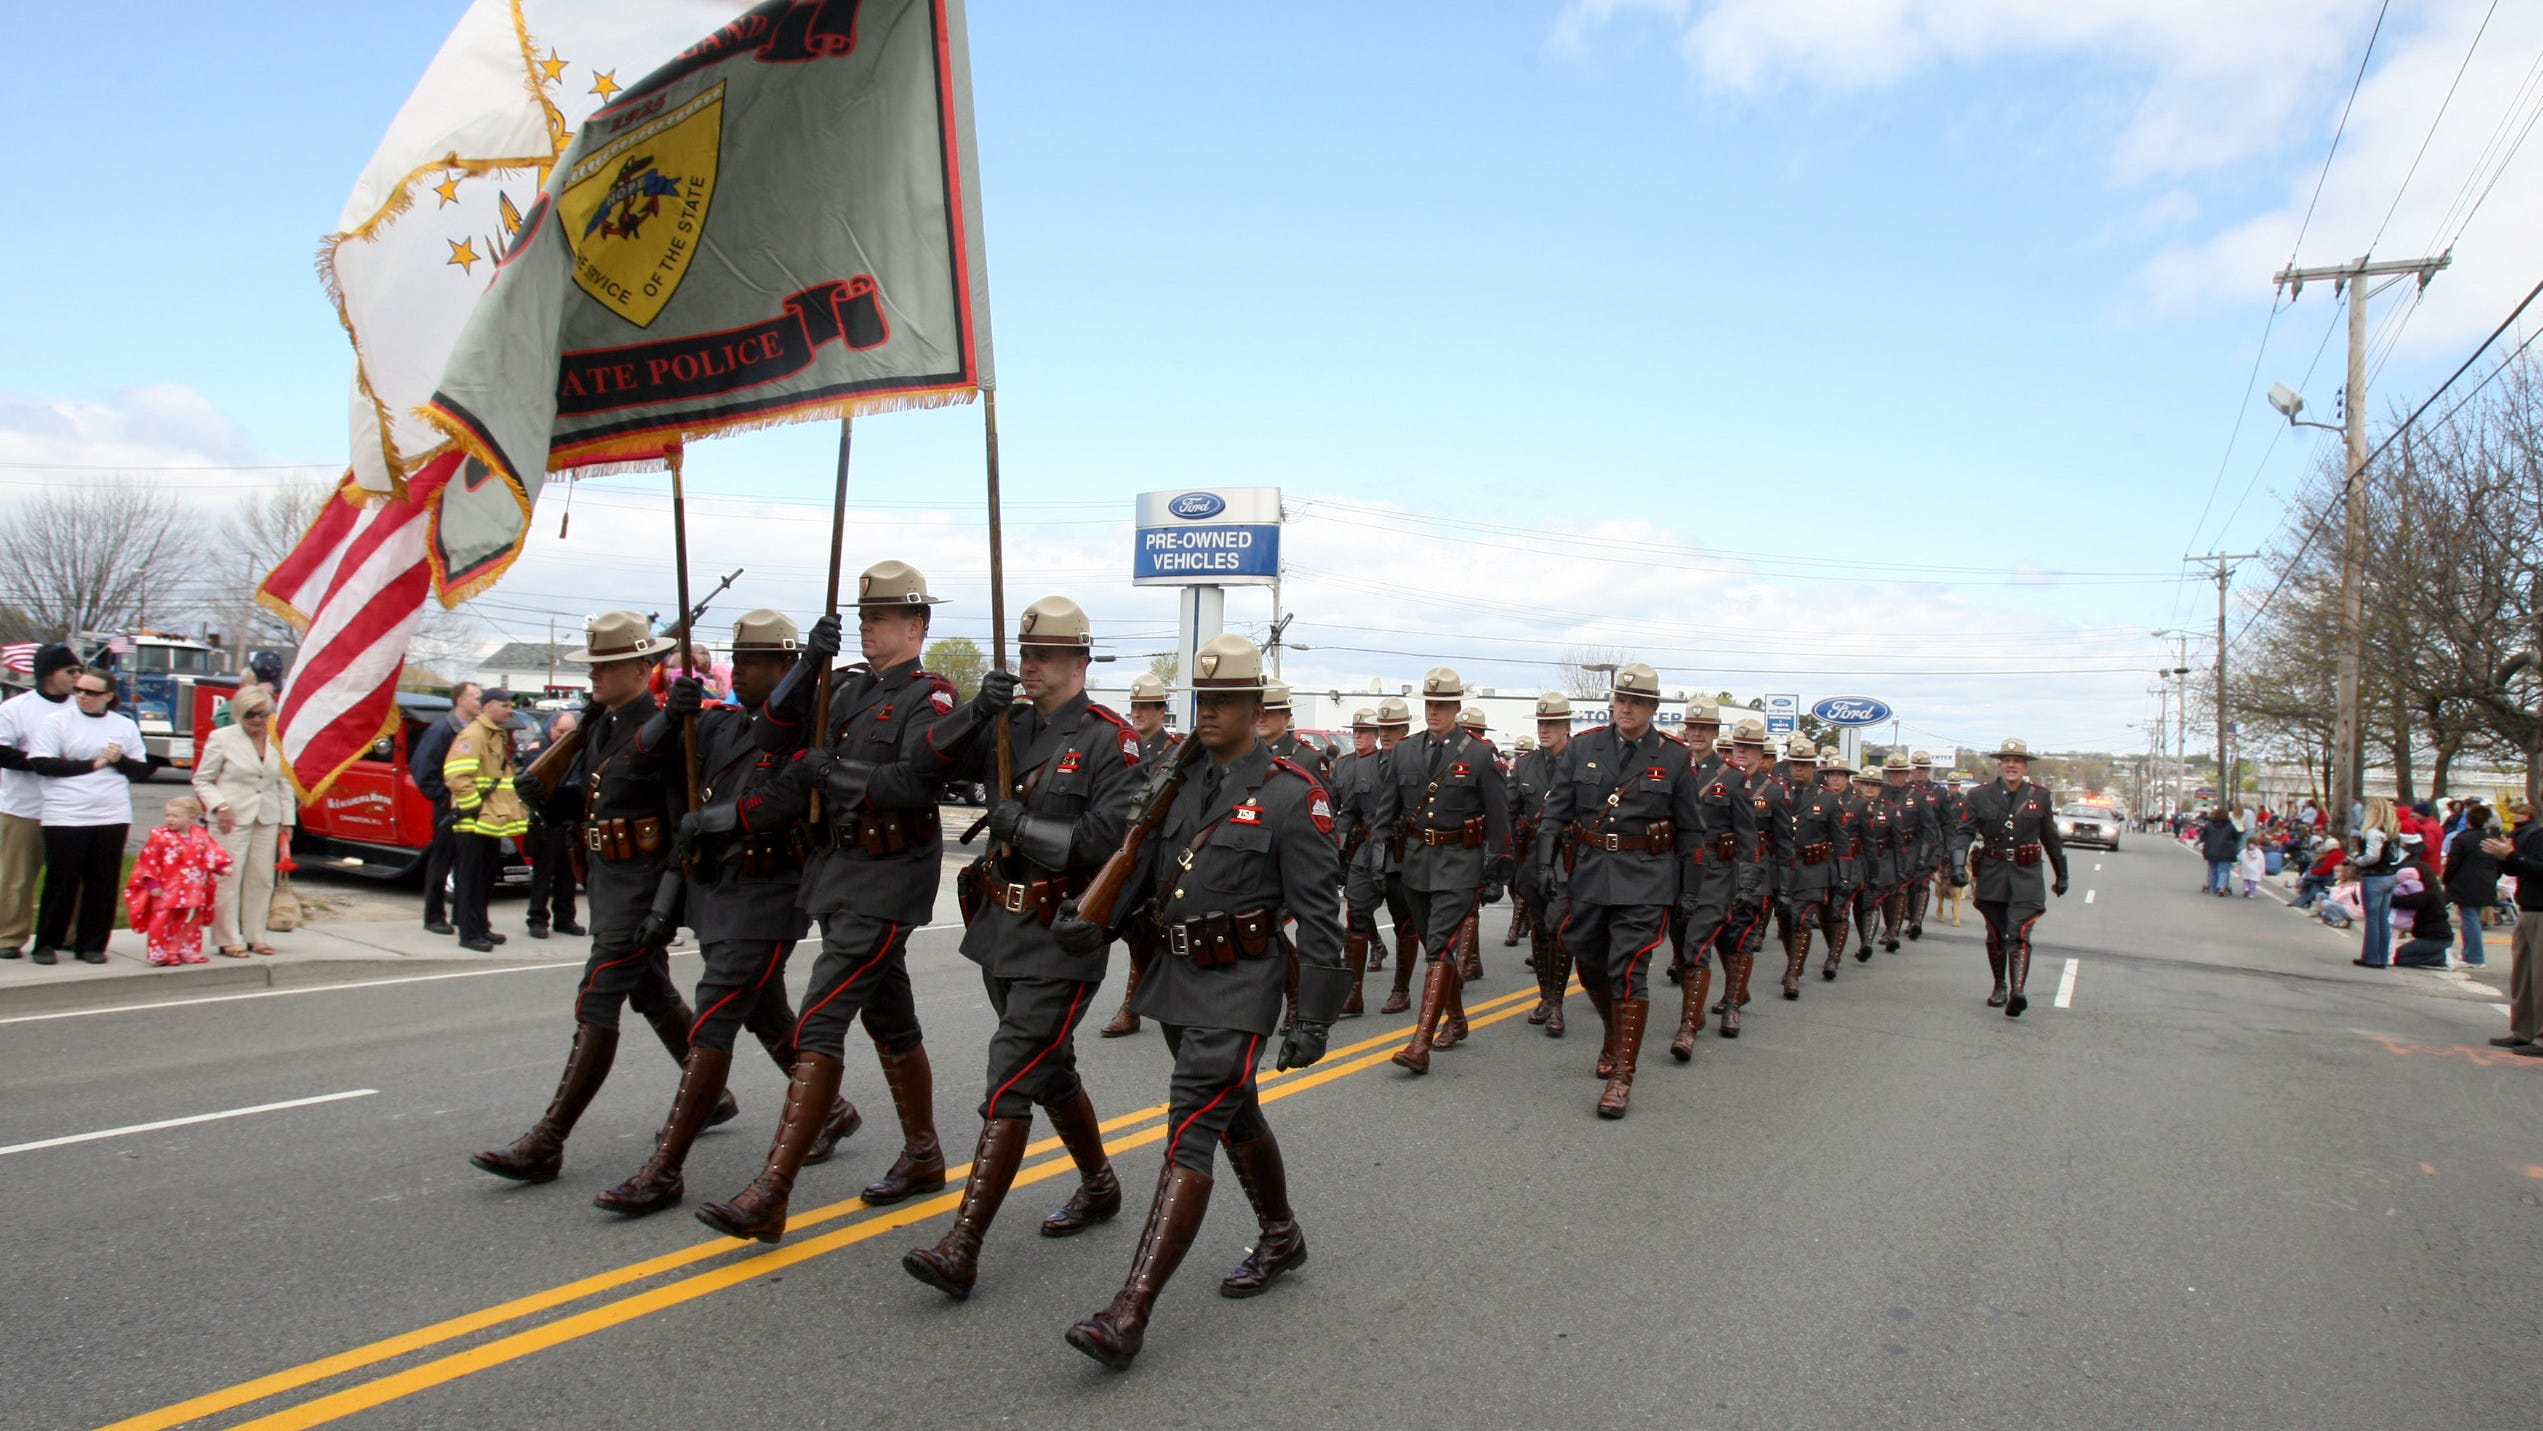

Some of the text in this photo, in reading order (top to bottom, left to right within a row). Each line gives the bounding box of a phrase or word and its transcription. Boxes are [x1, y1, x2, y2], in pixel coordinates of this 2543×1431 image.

[605, 176, 647, 207] HOPE
[643, 271, 664, 297] OF
[658, 236, 687, 272] THE
[678, 175, 705, 233] STATE
[560, 330, 785, 397] ATE POLICE
[1178, 496, 1210, 514] Ford
[1146, 531, 1252, 550] PRE-OWNED
[1153, 552, 1240, 570] VEHICLES
[1826, 700, 1875, 720] Ford
